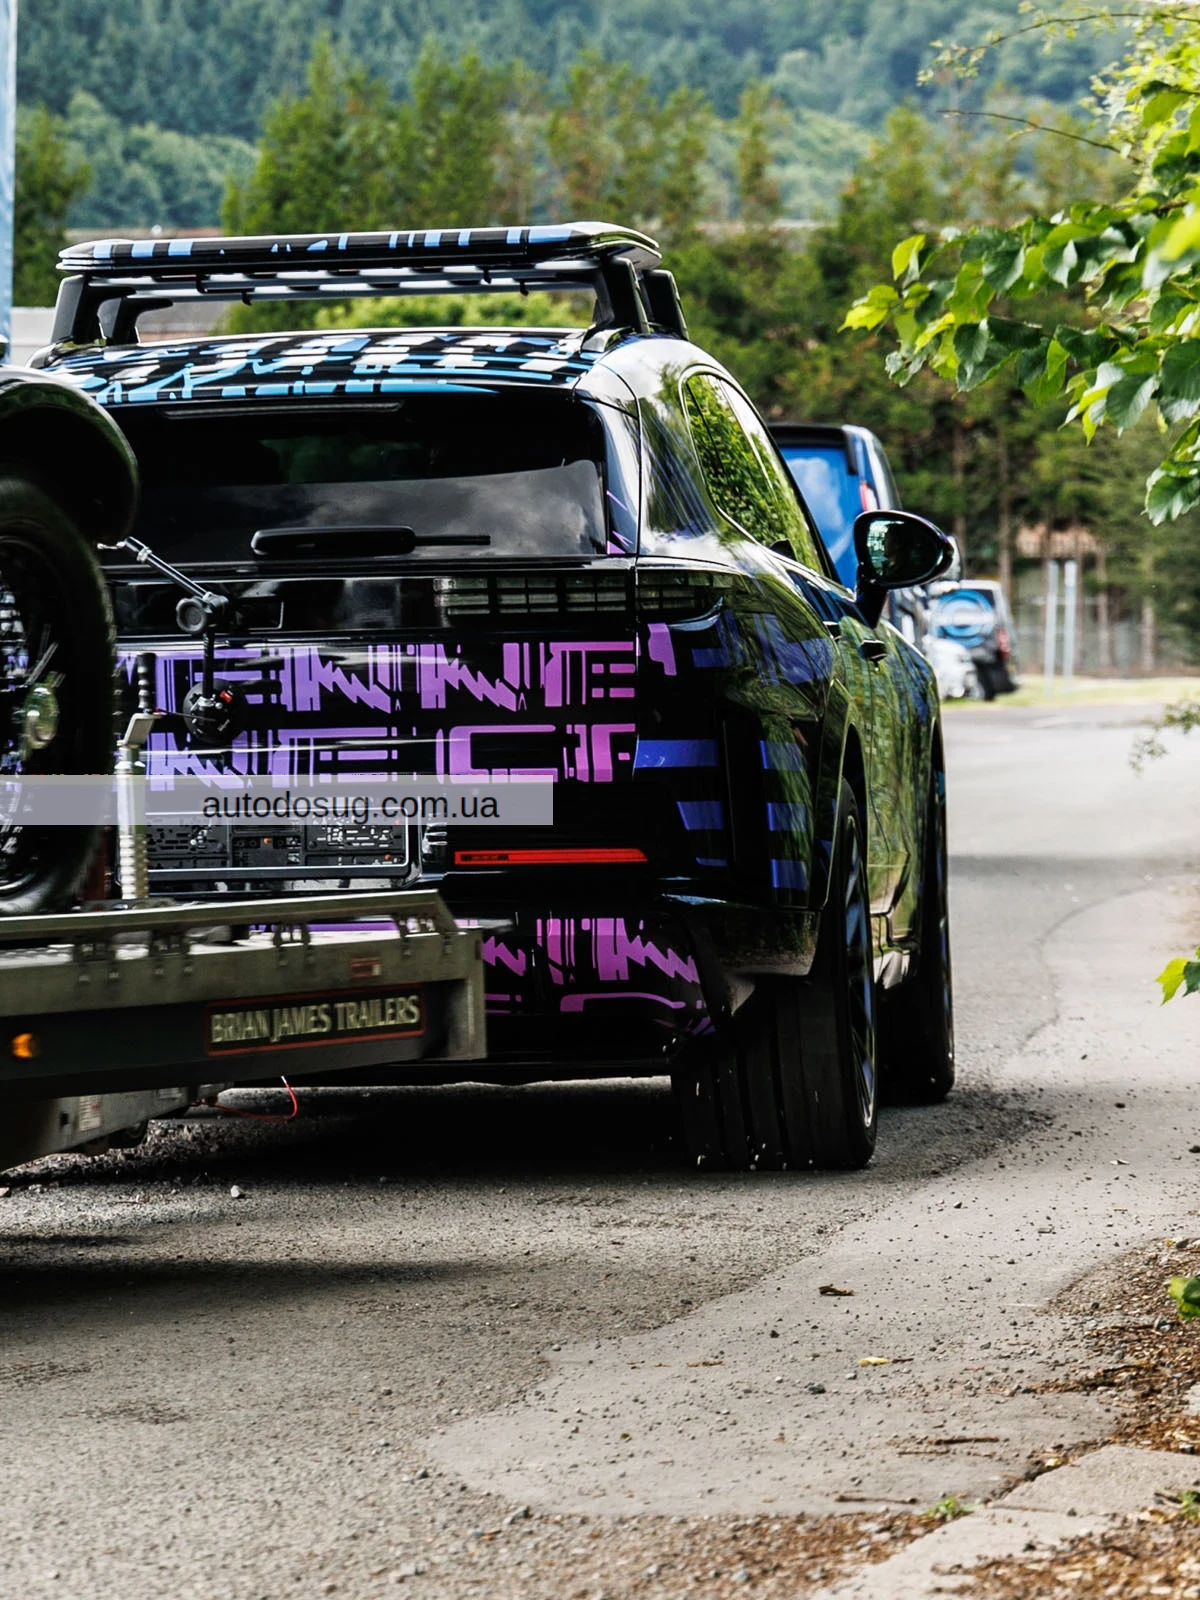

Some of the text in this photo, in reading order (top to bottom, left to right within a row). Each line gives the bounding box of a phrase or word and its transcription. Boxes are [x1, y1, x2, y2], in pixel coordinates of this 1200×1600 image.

[211, 995, 421, 1043] BRIAN JAMES TRAILERS
